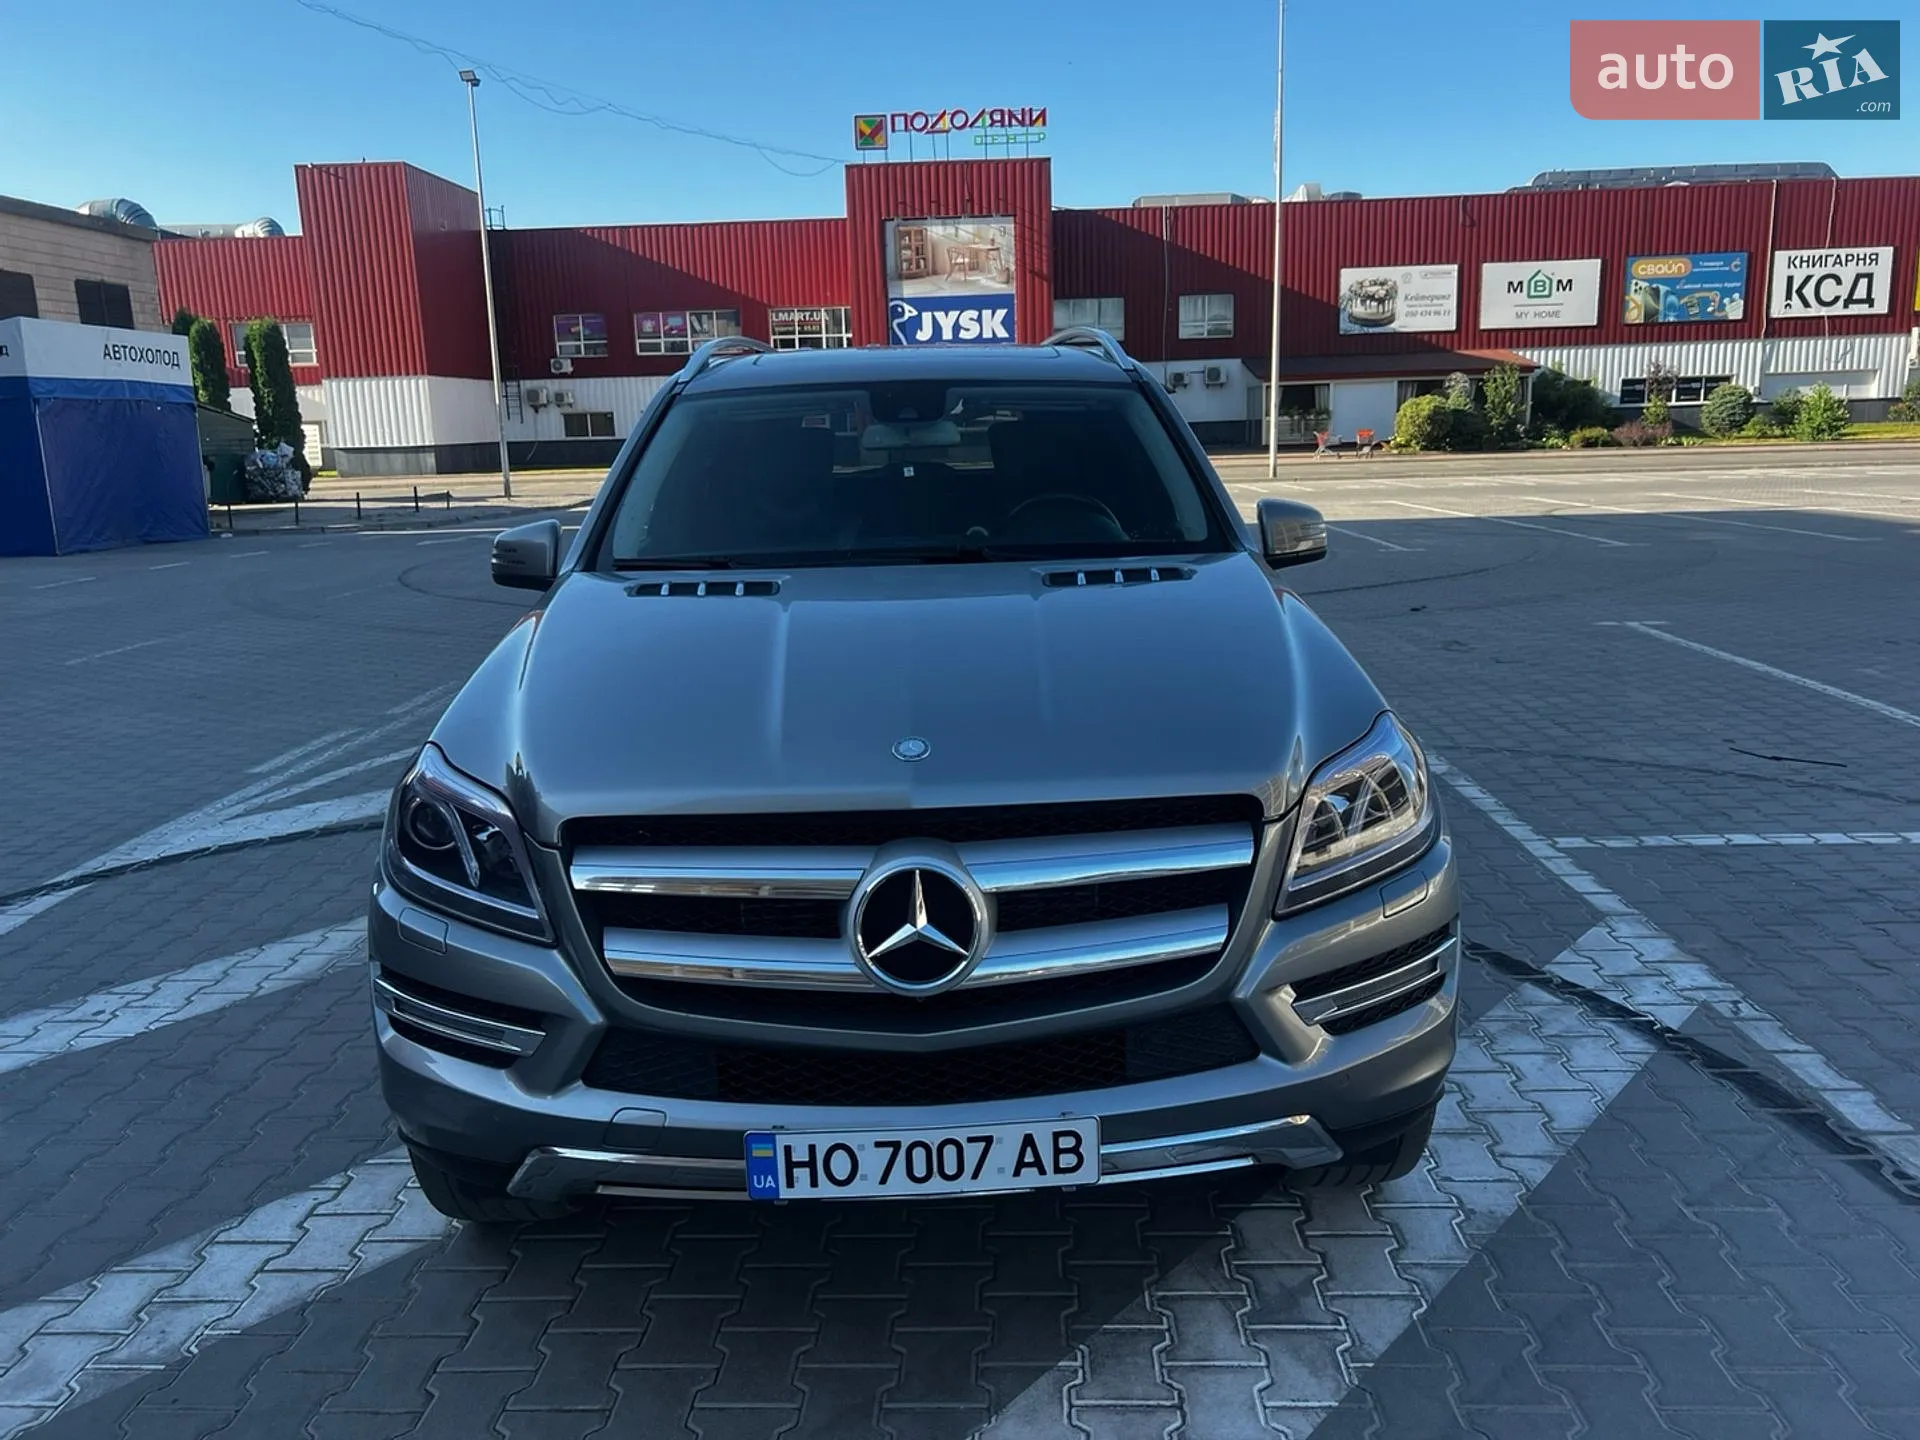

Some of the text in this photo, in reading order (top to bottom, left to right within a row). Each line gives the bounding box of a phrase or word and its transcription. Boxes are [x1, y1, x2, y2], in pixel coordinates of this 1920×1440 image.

[1787, 252, 1880, 269] КНИГАРНЯ
[1784, 271, 1875, 310] КСД
[915, 308, 1010, 342] JYSK
[1515, 310, 1562, 320] MY HOME
[102, 343, 181, 369] АВТОХОЛОД
[752, 1129, 1085, 1190] UA HO 7007 AB
